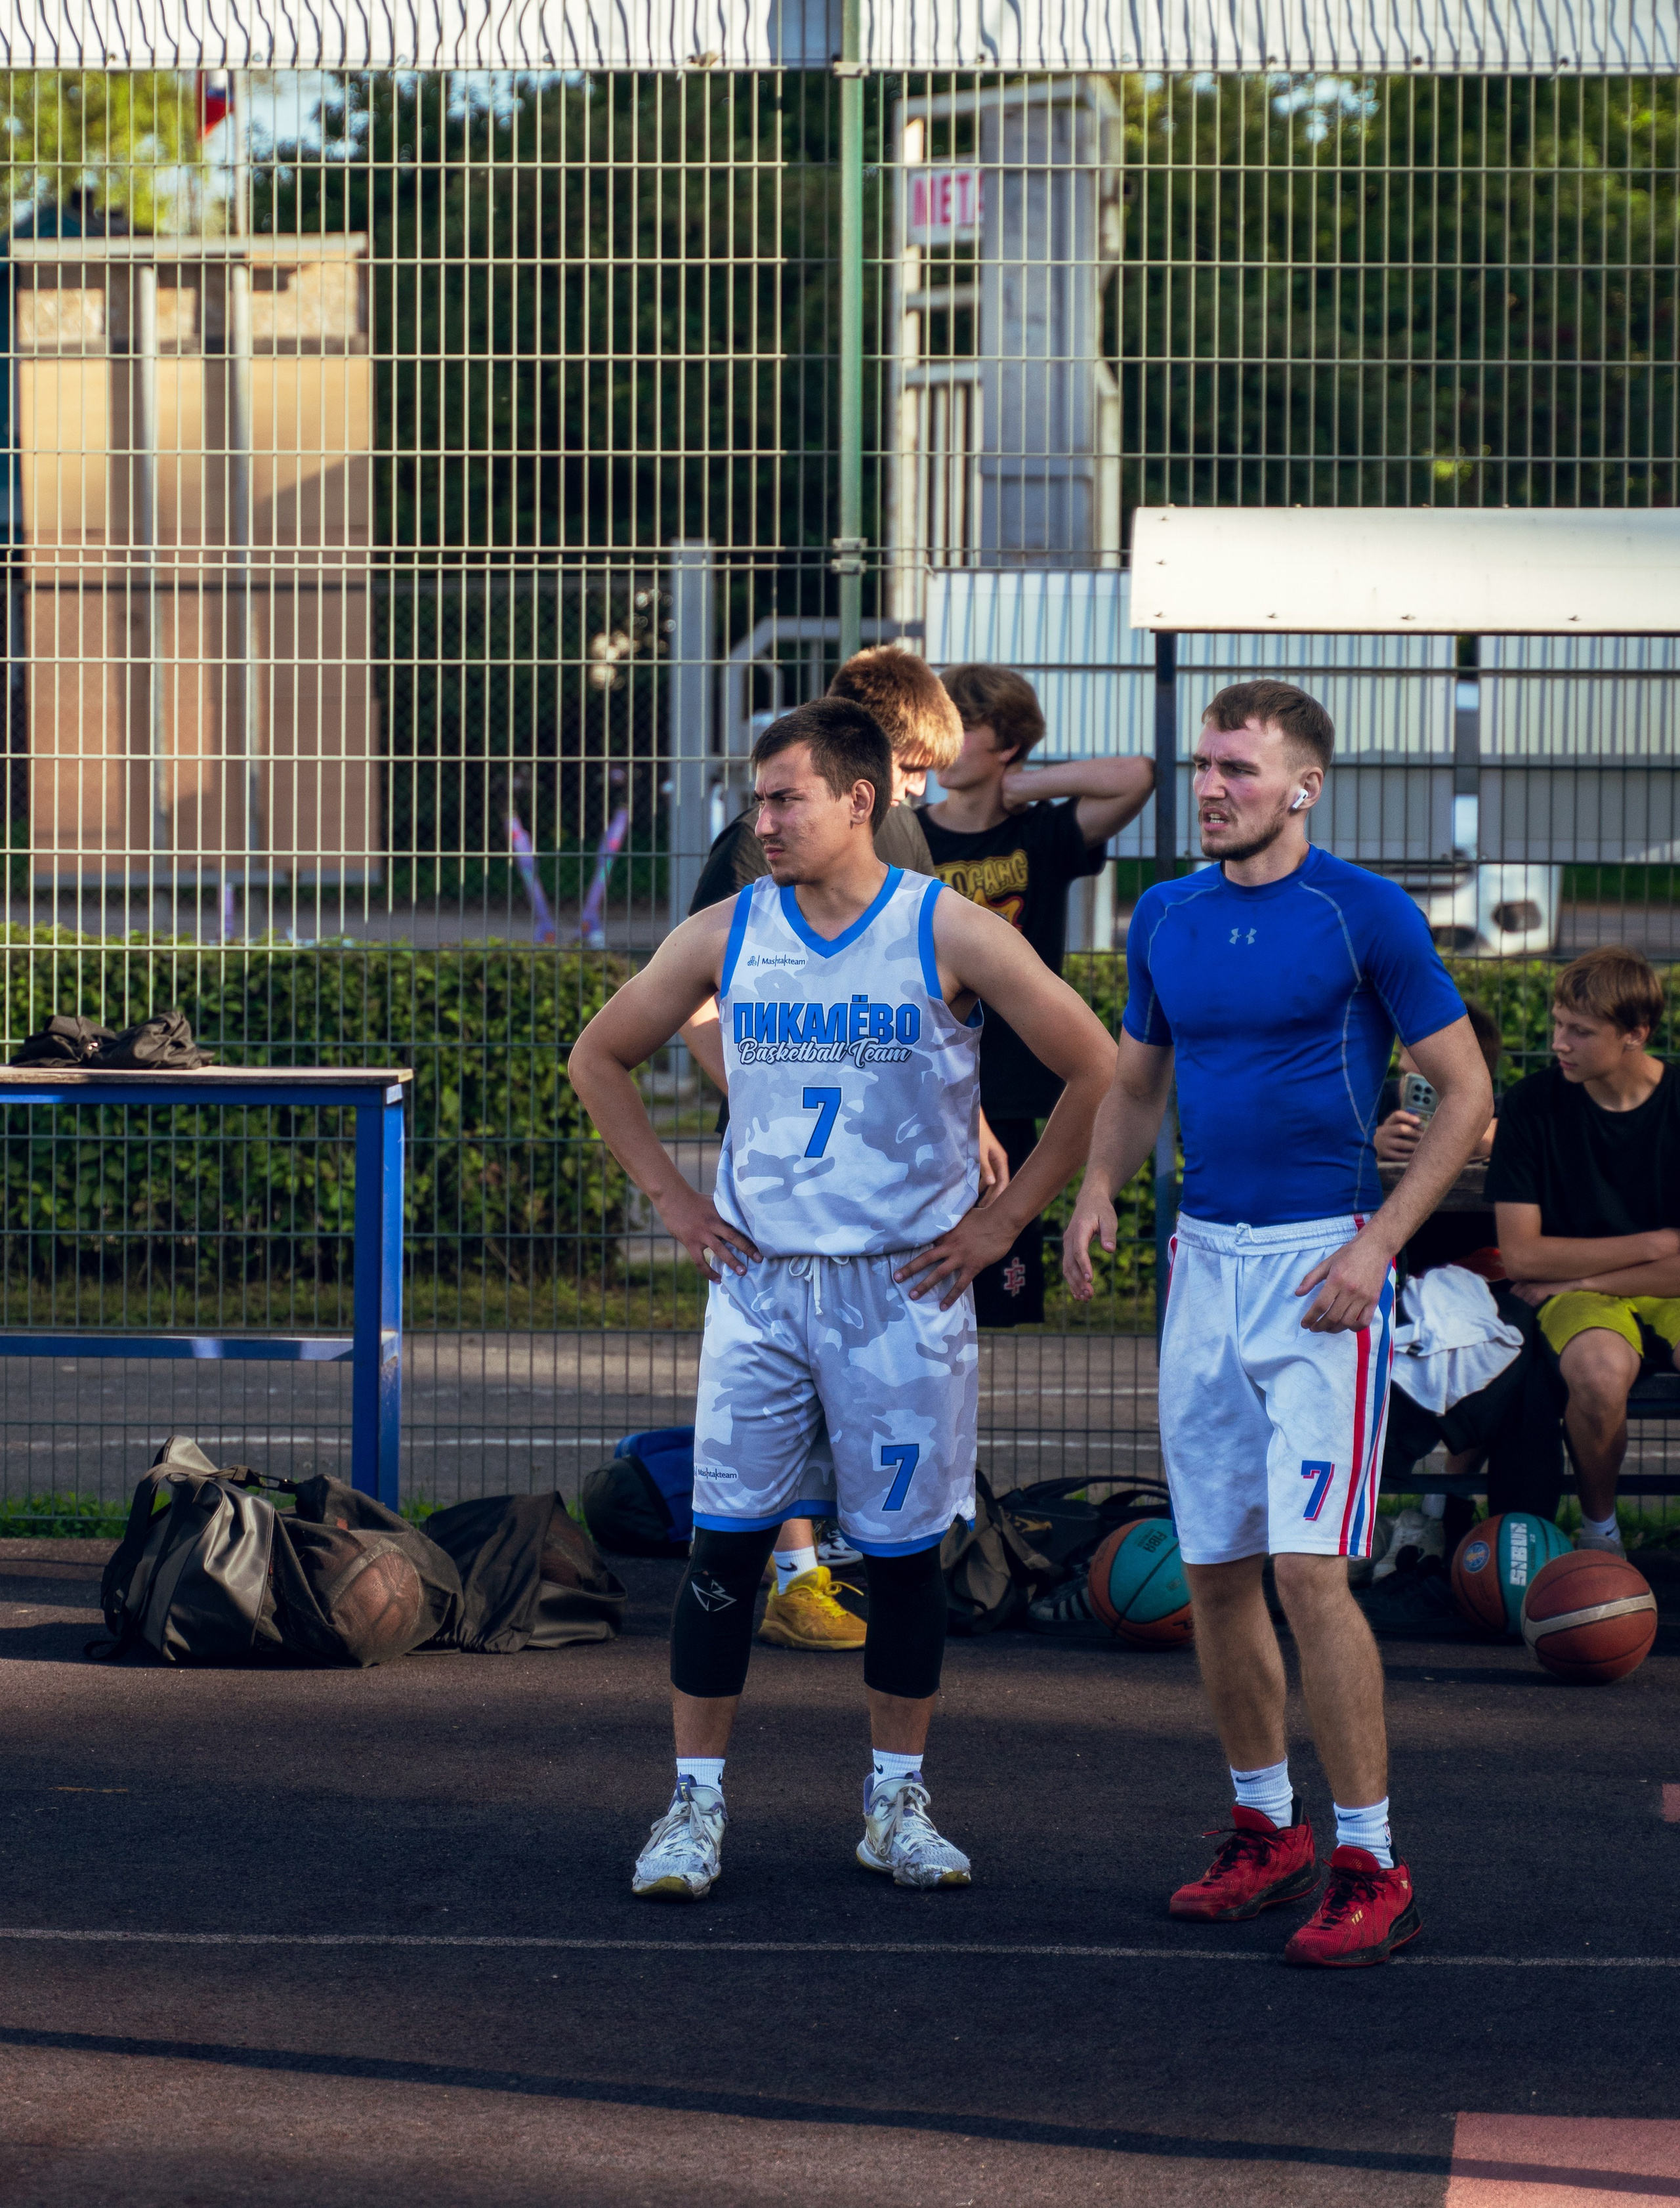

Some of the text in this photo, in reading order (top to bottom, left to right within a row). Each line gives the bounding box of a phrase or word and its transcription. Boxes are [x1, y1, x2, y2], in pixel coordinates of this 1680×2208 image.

[761, 954, 806, 967] Mashtakteam
[733, 994, 921, 1044] ПИКАЛЁВО
[738, 1036, 912, 1069] Basketball Team
[802, 1086, 843, 1158] 7
[698, 1467, 737, 1480] Mashtakteam
[881, 1443, 919, 1512] 7
[1301, 1460, 1335, 1521] 7
[1143, 1530, 1168, 1553] FIBA
